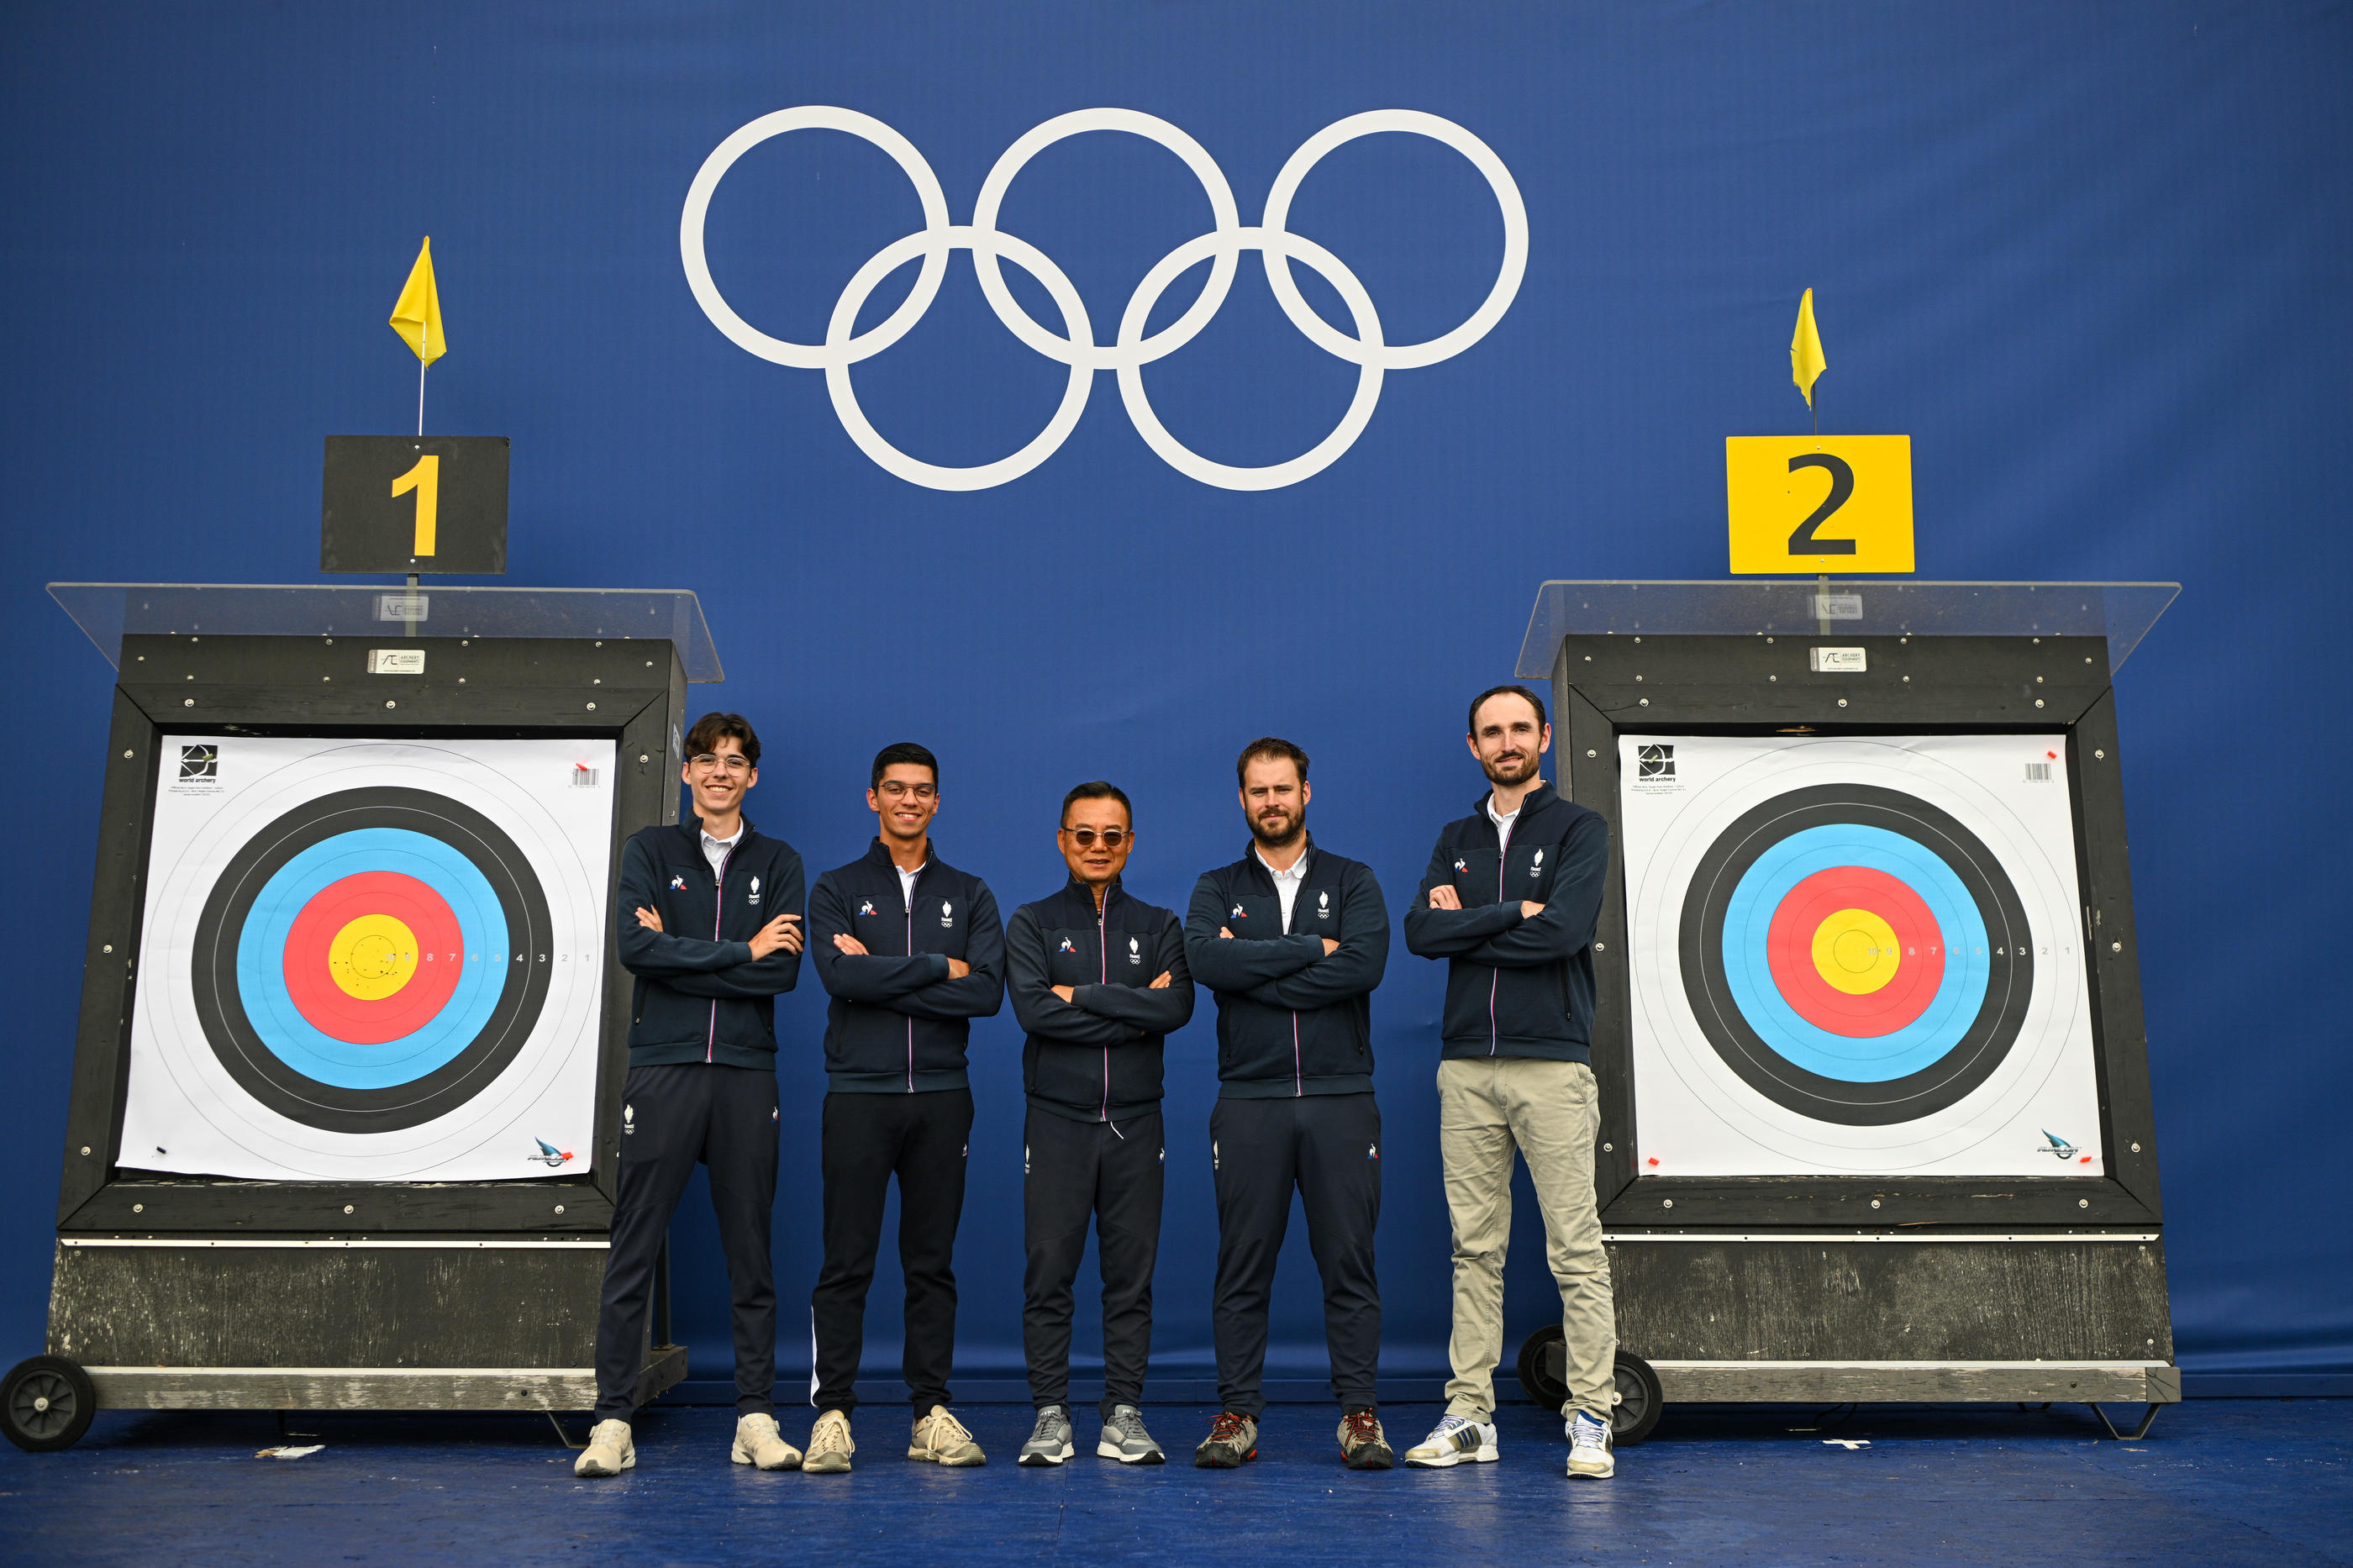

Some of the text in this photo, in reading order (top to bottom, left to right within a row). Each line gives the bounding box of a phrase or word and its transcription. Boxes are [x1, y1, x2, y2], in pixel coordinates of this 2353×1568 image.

[392, 455, 439, 556] 1
[1788, 453, 1856, 556] 2
[426, 953, 434, 962] 8
[450, 953, 456, 962] 7
[471, 953, 479, 962] 6
[494, 953, 501, 962] 5
[516, 953, 524, 962] 4
[539, 953, 546, 962] 3
[561, 953, 568, 962] 2
[584, 953, 589, 962] 1
[1867, 947, 2070, 955] 10 9 8 7 6 5 4 3 2 1
